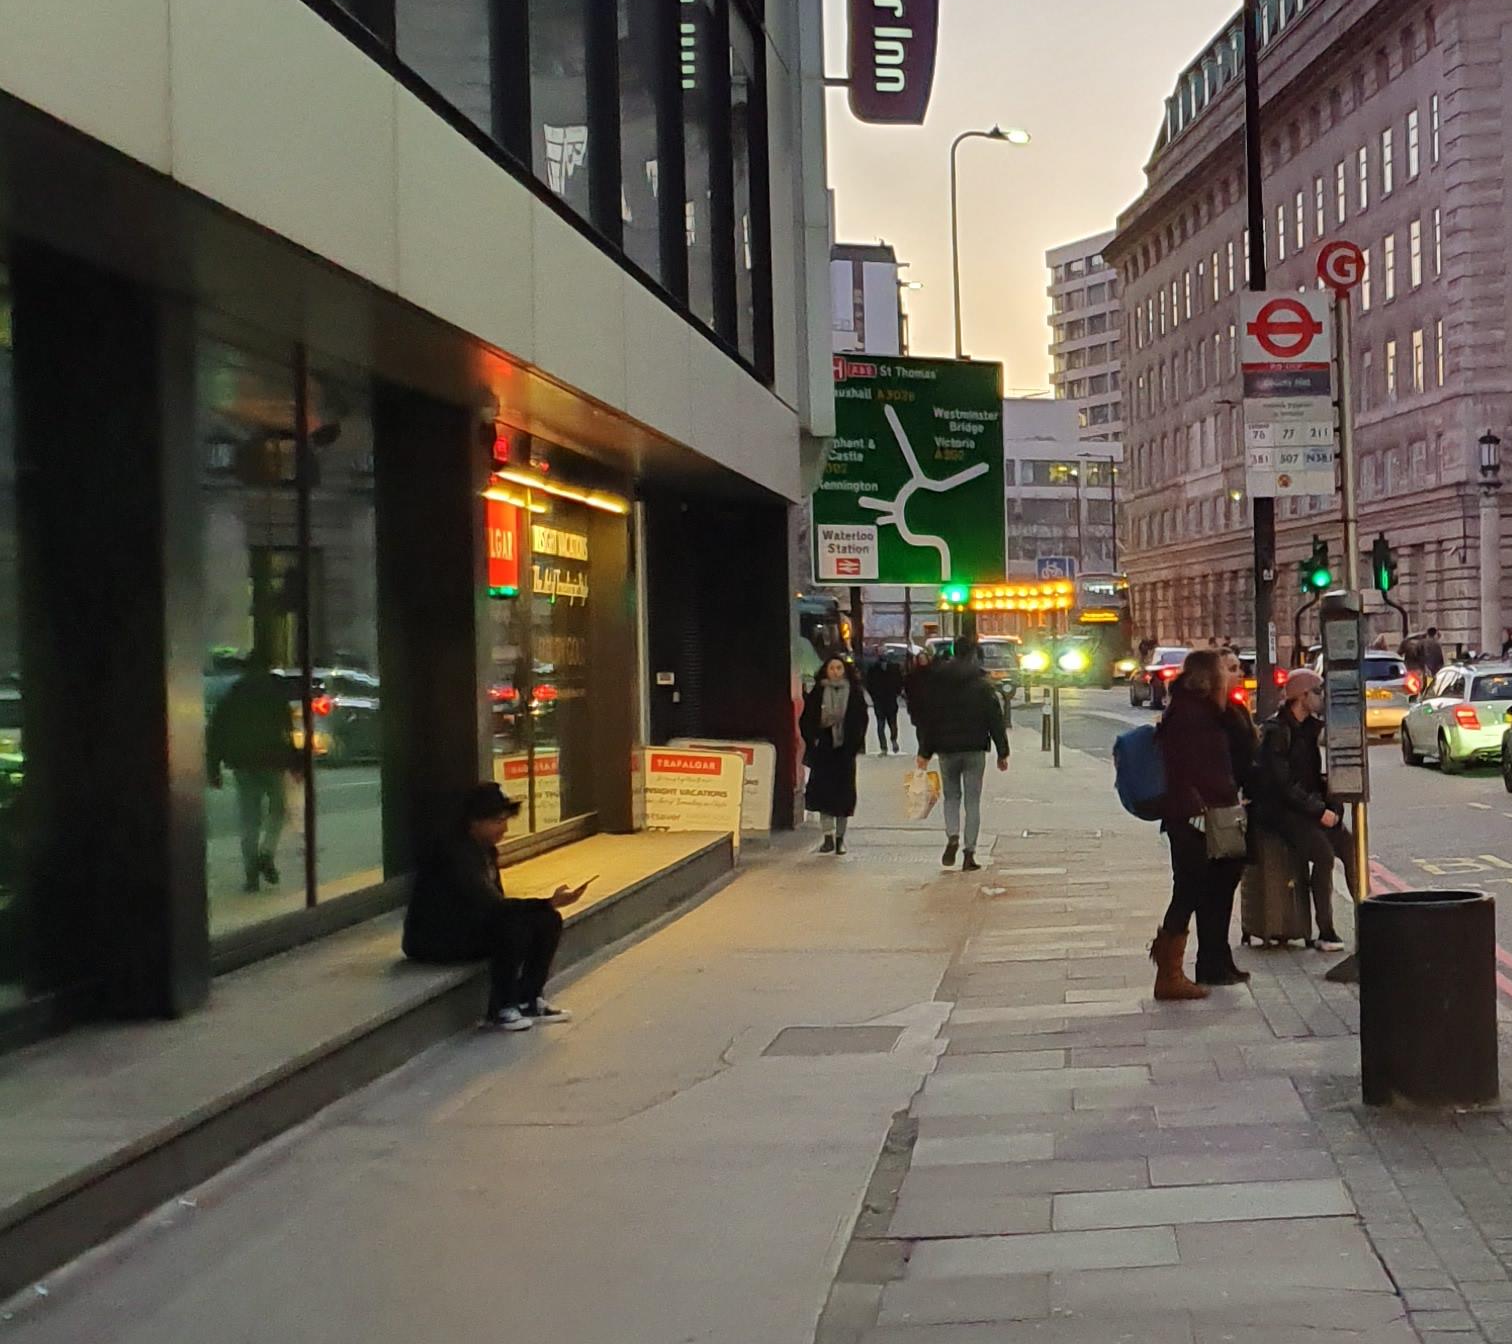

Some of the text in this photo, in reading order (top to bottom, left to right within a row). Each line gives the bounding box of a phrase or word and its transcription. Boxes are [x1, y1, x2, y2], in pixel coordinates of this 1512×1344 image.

[874, 26, 913, 94] Inn
[1326, 247, 1357, 284] G
[879, 365, 892, 377] St
[834, 387, 873, 399] auxhall
[932, 405, 999, 421] Westminster
[949, 421, 985, 435] Bridge
[1253, 430, 1266, 440] 76
[1310, 428, 1328, 439] 211
[832, 437, 864, 449] phant
[934, 436, 976, 448] Victoria
[828, 450, 864, 462] Castle
[1280, 454, 1299, 464] 507
[822, 529, 874, 542] Waterloo
[828, 543, 869, 555] Station
[657, 759, 716, 770] TRAFALGAR
[680, 789, 728, 799] VACATIONS
